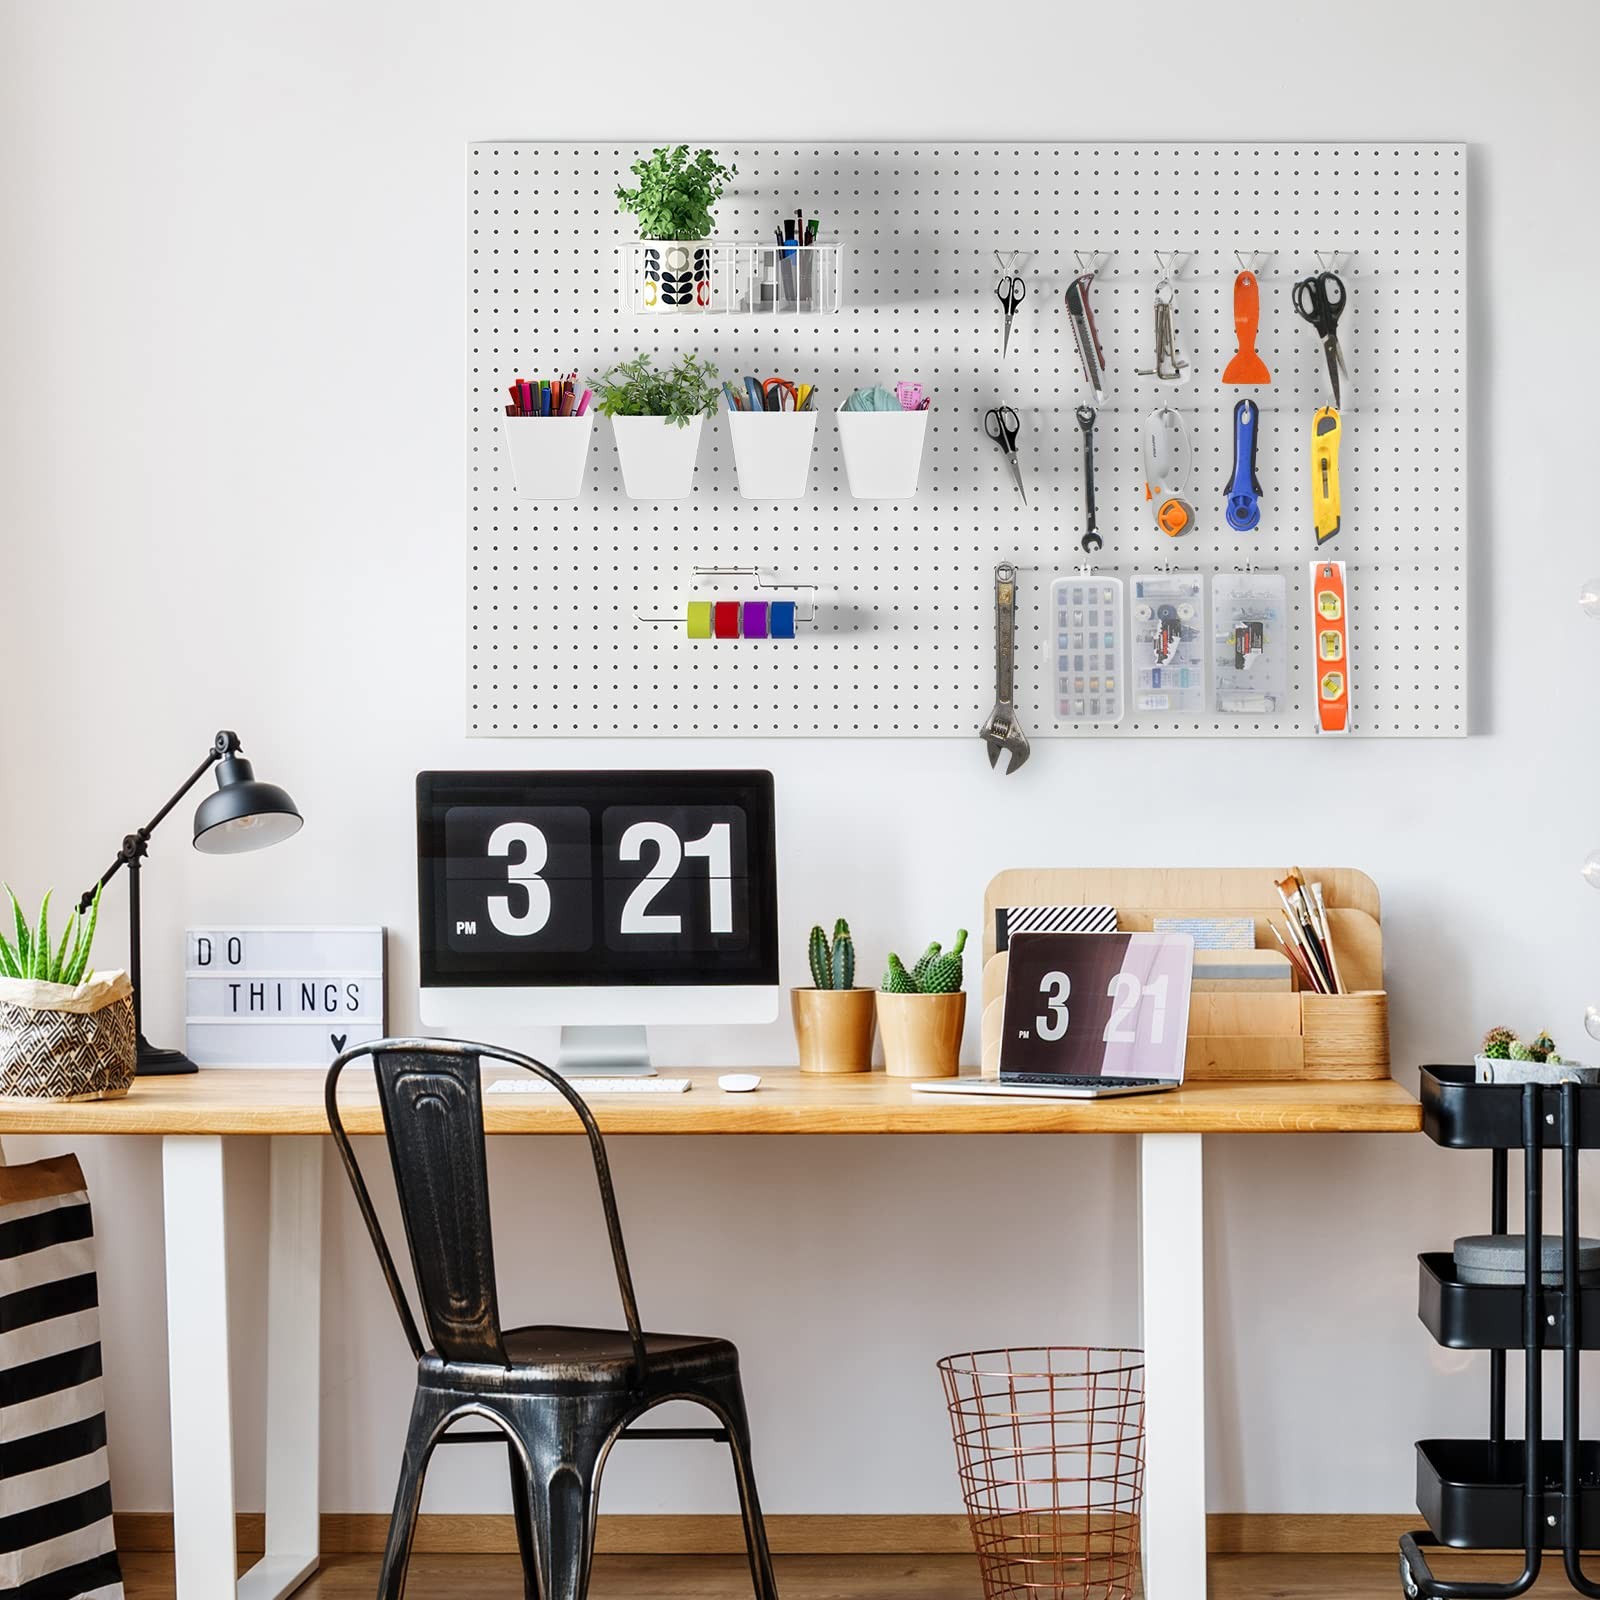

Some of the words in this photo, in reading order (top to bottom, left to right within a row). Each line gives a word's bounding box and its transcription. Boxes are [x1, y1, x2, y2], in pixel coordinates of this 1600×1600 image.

[456, 921, 477, 935] PM
[487, 821, 551, 936] 3
[619, 821, 733, 933] 21
[198, 937, 241, 966] DO
[229, 983, 359, 1013] THINGS
[1018, 1030, 1030, 1039] PM
[1035, 970, 1071, 1041] 3
[1102, 972, 1169, 1043] 21
